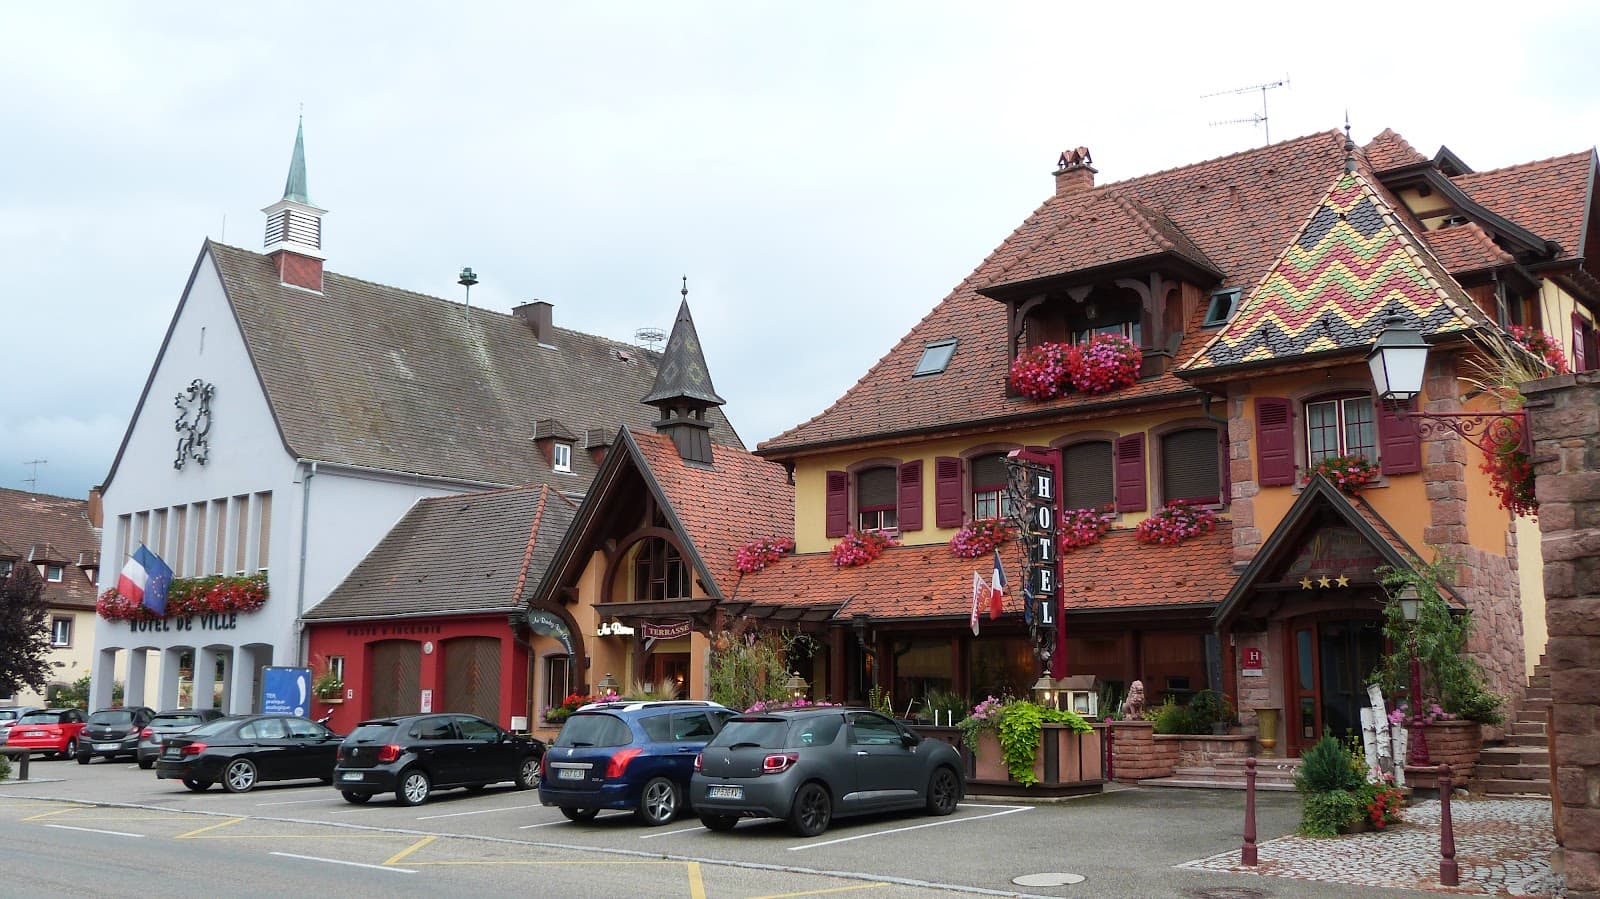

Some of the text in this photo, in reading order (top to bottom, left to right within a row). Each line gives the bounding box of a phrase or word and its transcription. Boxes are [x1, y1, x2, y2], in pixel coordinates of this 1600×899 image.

[1037, 475, 1053, 624] HOTEL
[176, 614, 192, 631] DE
[200, 612, 237, 630] VILLE
[649, 624, 690, 636] TERRASSE
[1250, 651, 1259, 661] H
